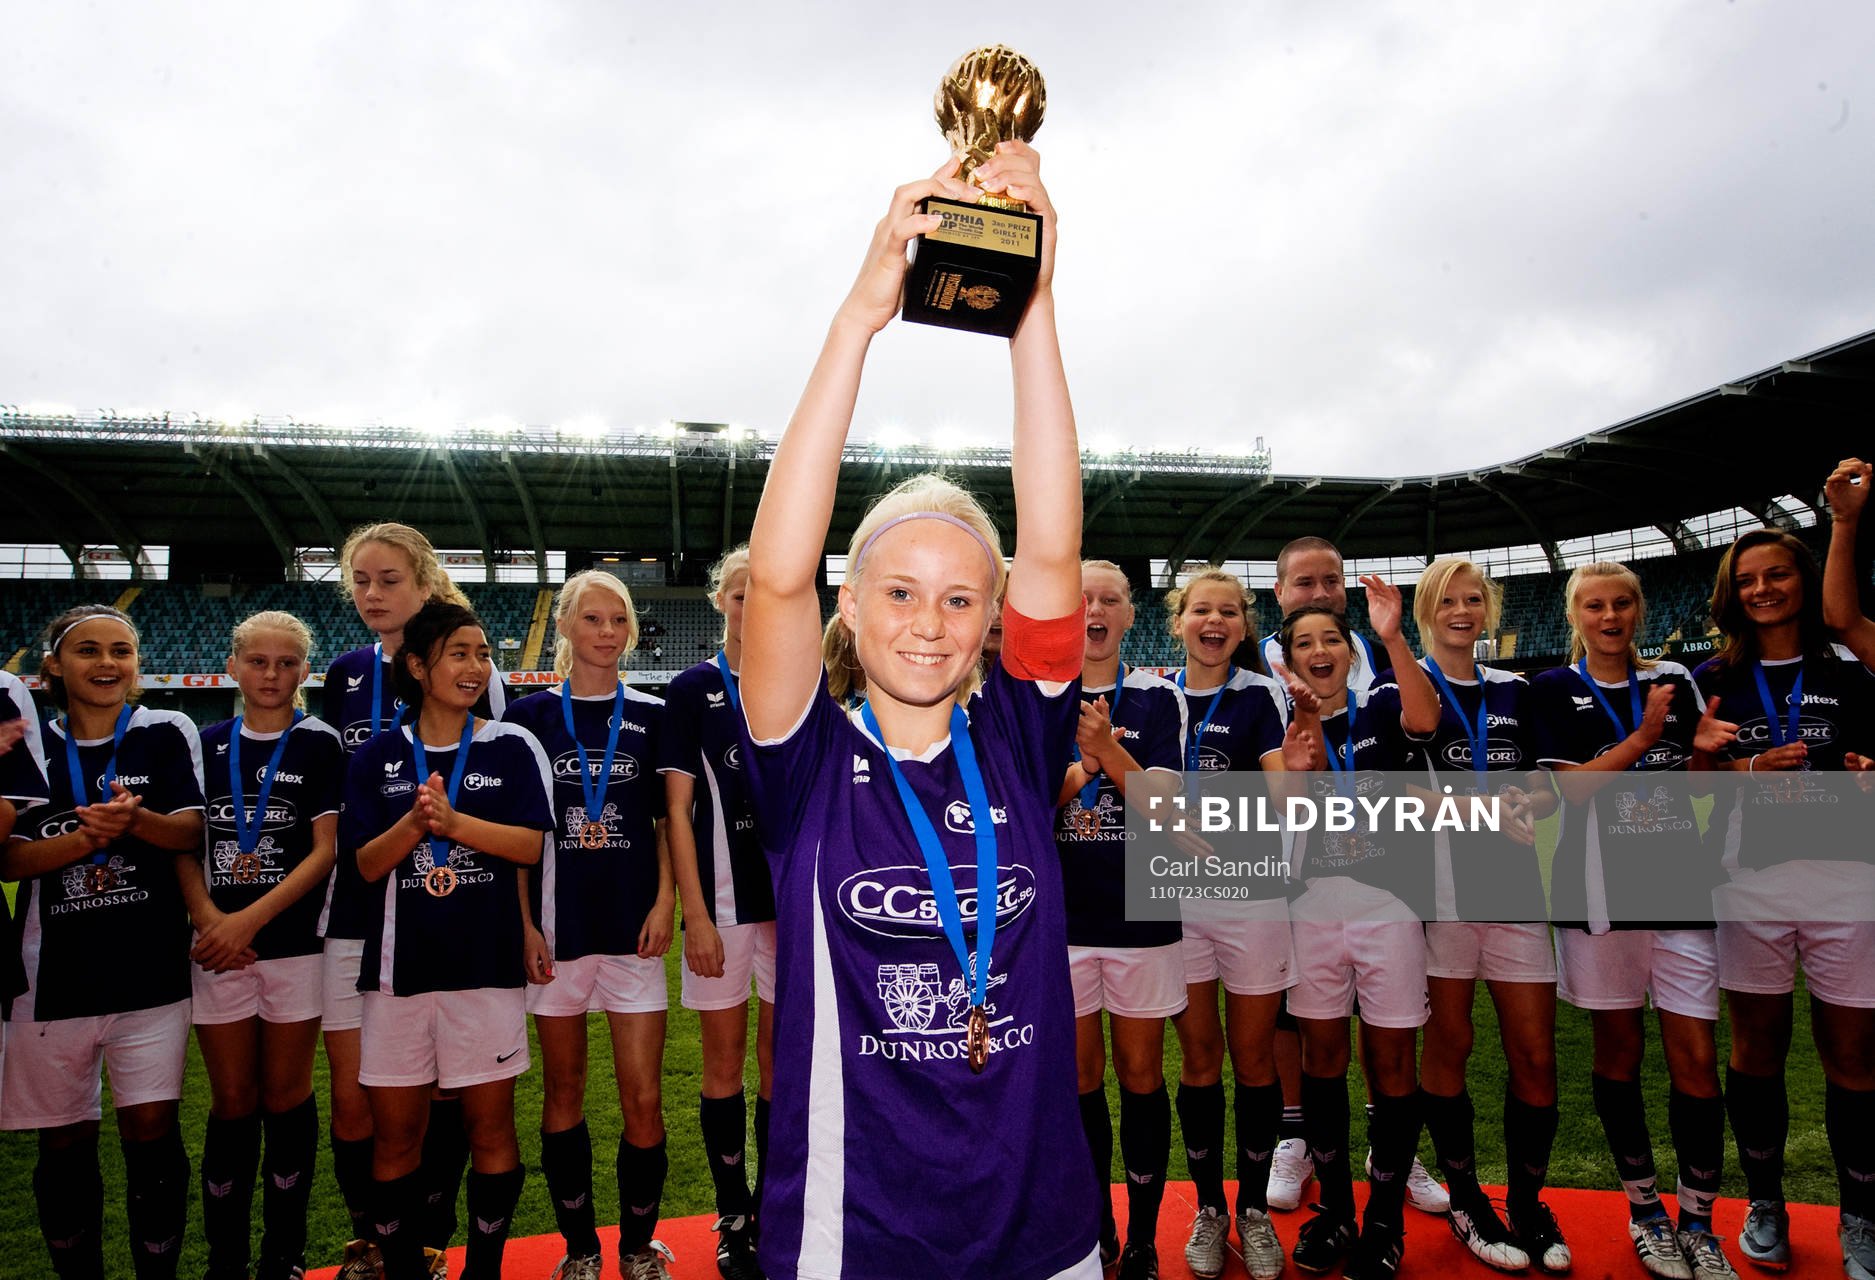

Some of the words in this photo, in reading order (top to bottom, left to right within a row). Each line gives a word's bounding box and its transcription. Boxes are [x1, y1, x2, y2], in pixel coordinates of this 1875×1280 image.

[940, 220, 957, 229] UP
[1007, 223, 1031, 232] PRIZE
[992, 228, 1017, 238] GIRLS
[1000, 238, 1020, 246] 2011
[183, 675, 225, 686] GT
[51, 890, 149, 915] DUNROSS&CO
[858, 1024, 1034, 1062] DUNROS&CO
